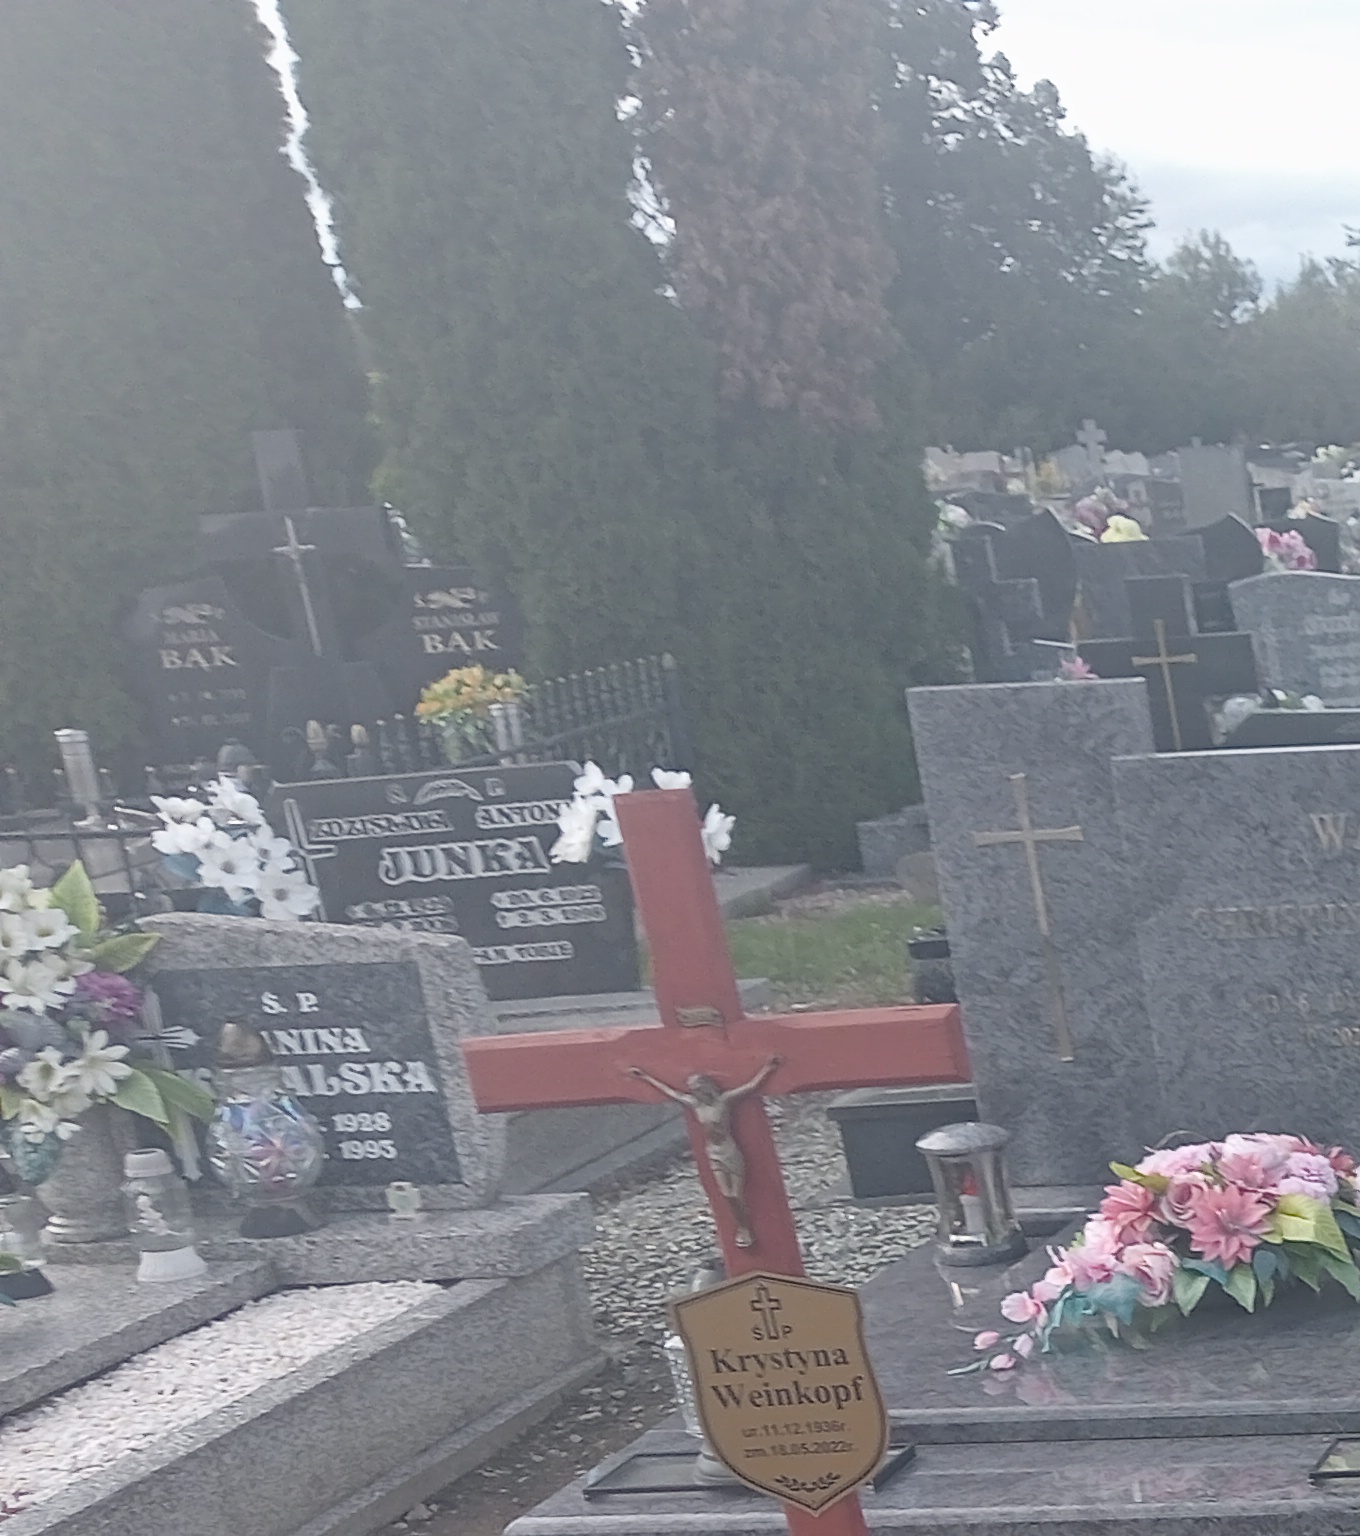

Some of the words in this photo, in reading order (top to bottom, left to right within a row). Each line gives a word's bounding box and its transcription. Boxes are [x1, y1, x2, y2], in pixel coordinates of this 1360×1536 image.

[421, 629, 501, 656] BAK
[158, 646, 239, 672] BAK
[478, 799, 570, 827] ANTON
[380, 837, 550, 884] JUNKA
[331, 1111, 393, 1133] 1928
[338, 1139, 399, 1160] 1995
[710, 1347, 850, 1378] Krystyna
[711, 1374, 866, 1411] Weinkopf
